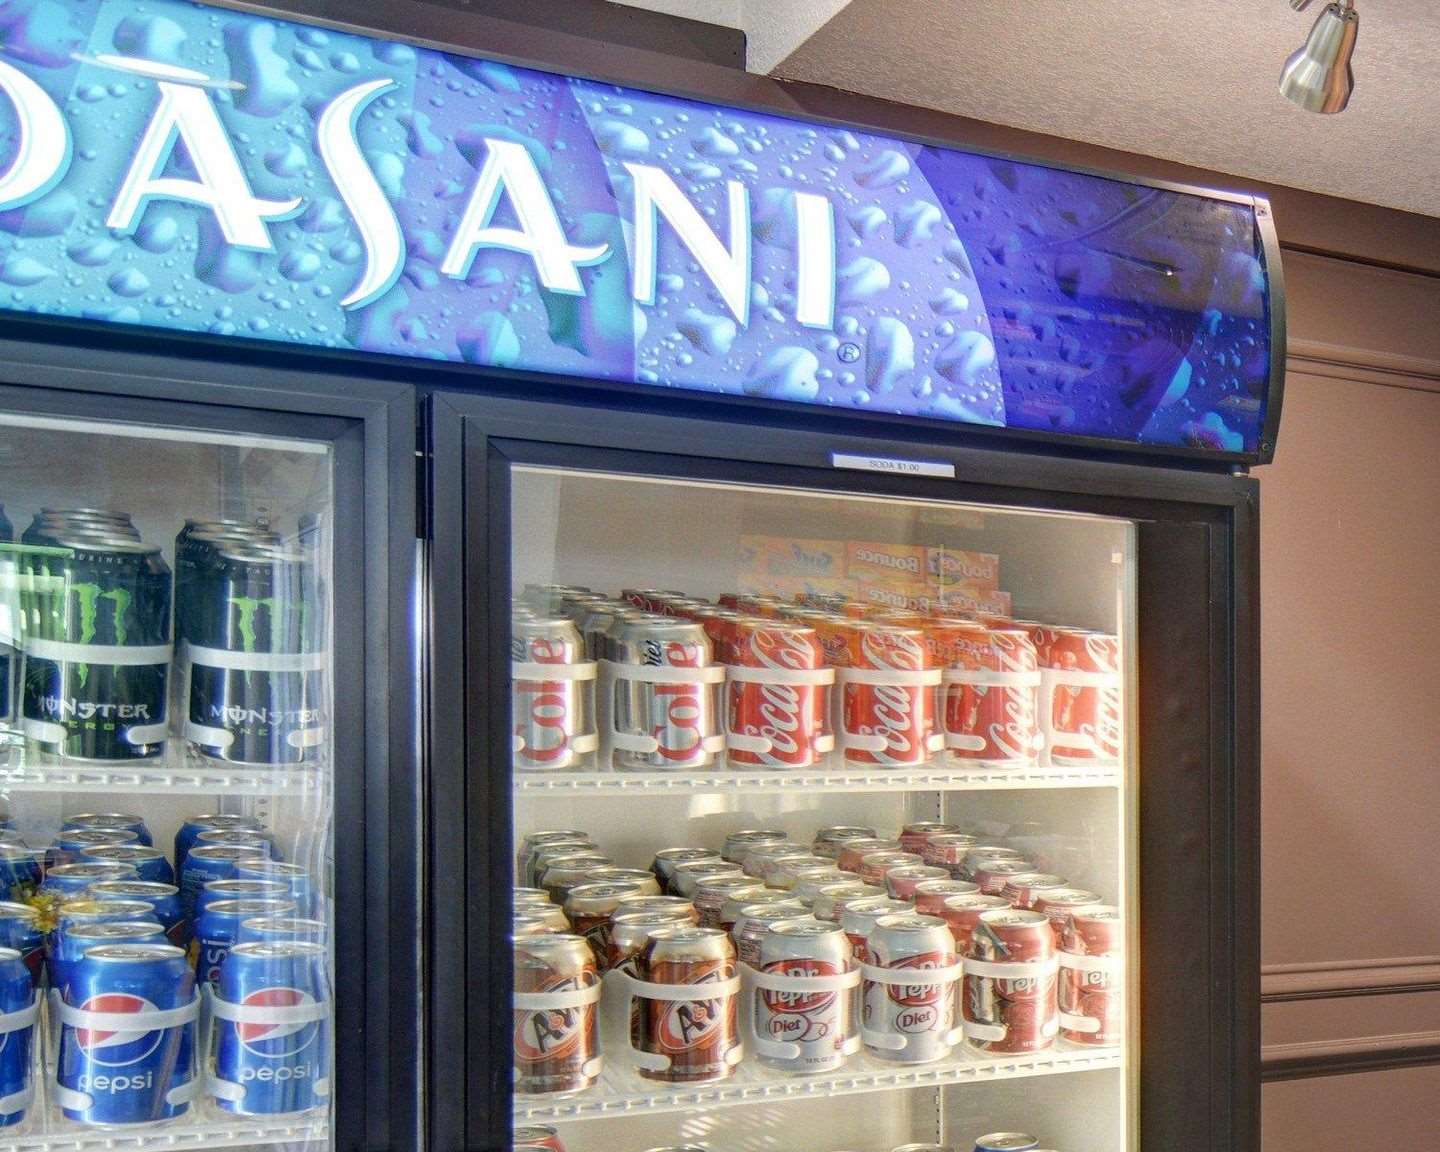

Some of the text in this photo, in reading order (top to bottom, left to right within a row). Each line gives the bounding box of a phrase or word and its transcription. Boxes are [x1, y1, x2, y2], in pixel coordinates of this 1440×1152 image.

[870, 460, 895, 470] SODA
[902, 1010, 931, 1026] Diet
[772, 1019, 801, 1035] Diet
[78, 1071, 153, 1094] pepsi
[238, 1064, 314, 1085] pepsi
